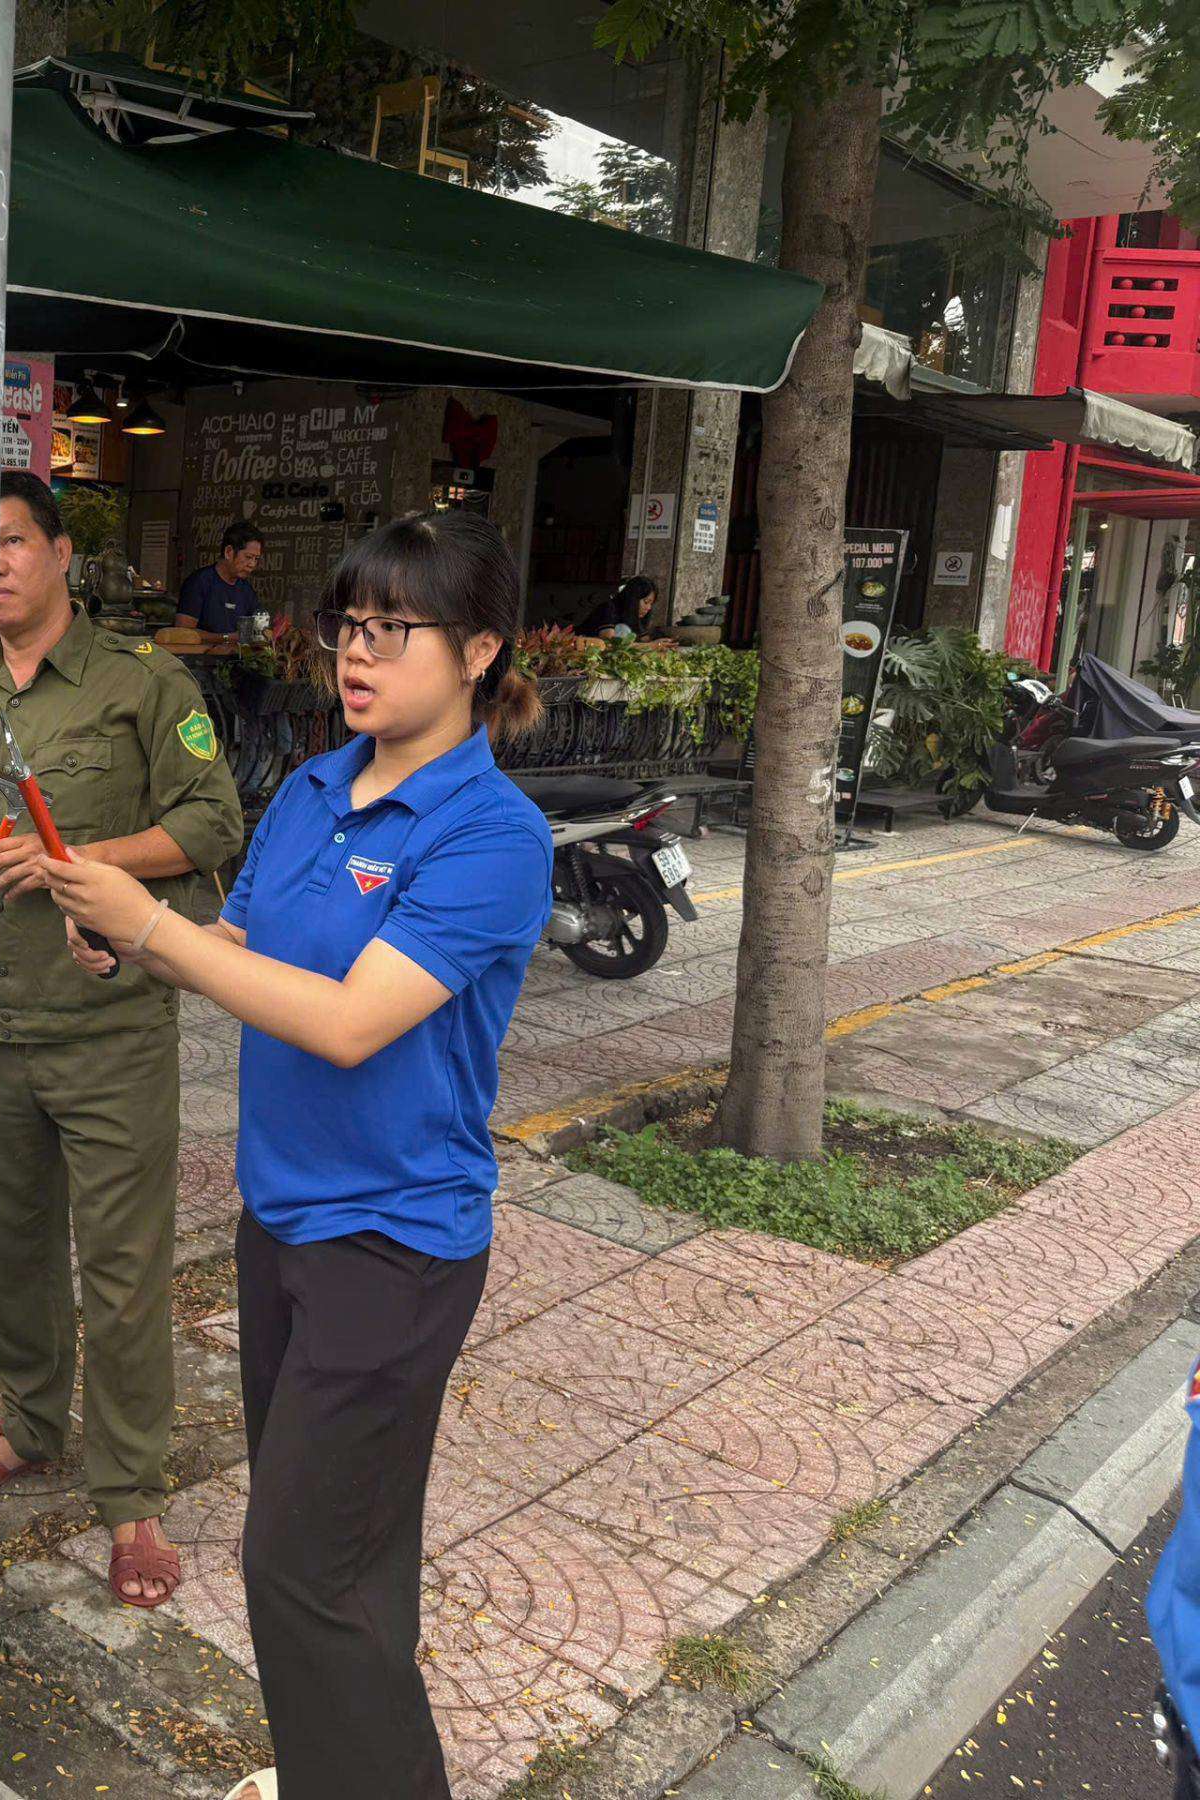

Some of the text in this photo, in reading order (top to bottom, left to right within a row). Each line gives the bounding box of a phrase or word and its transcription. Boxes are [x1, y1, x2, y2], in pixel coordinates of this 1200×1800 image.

[309, 408, 346, 431] CUP
[353, 404, 379, 424] MY
[211, 444, 278, 484] Coffee
[872, 543, 895, 554] MENU
